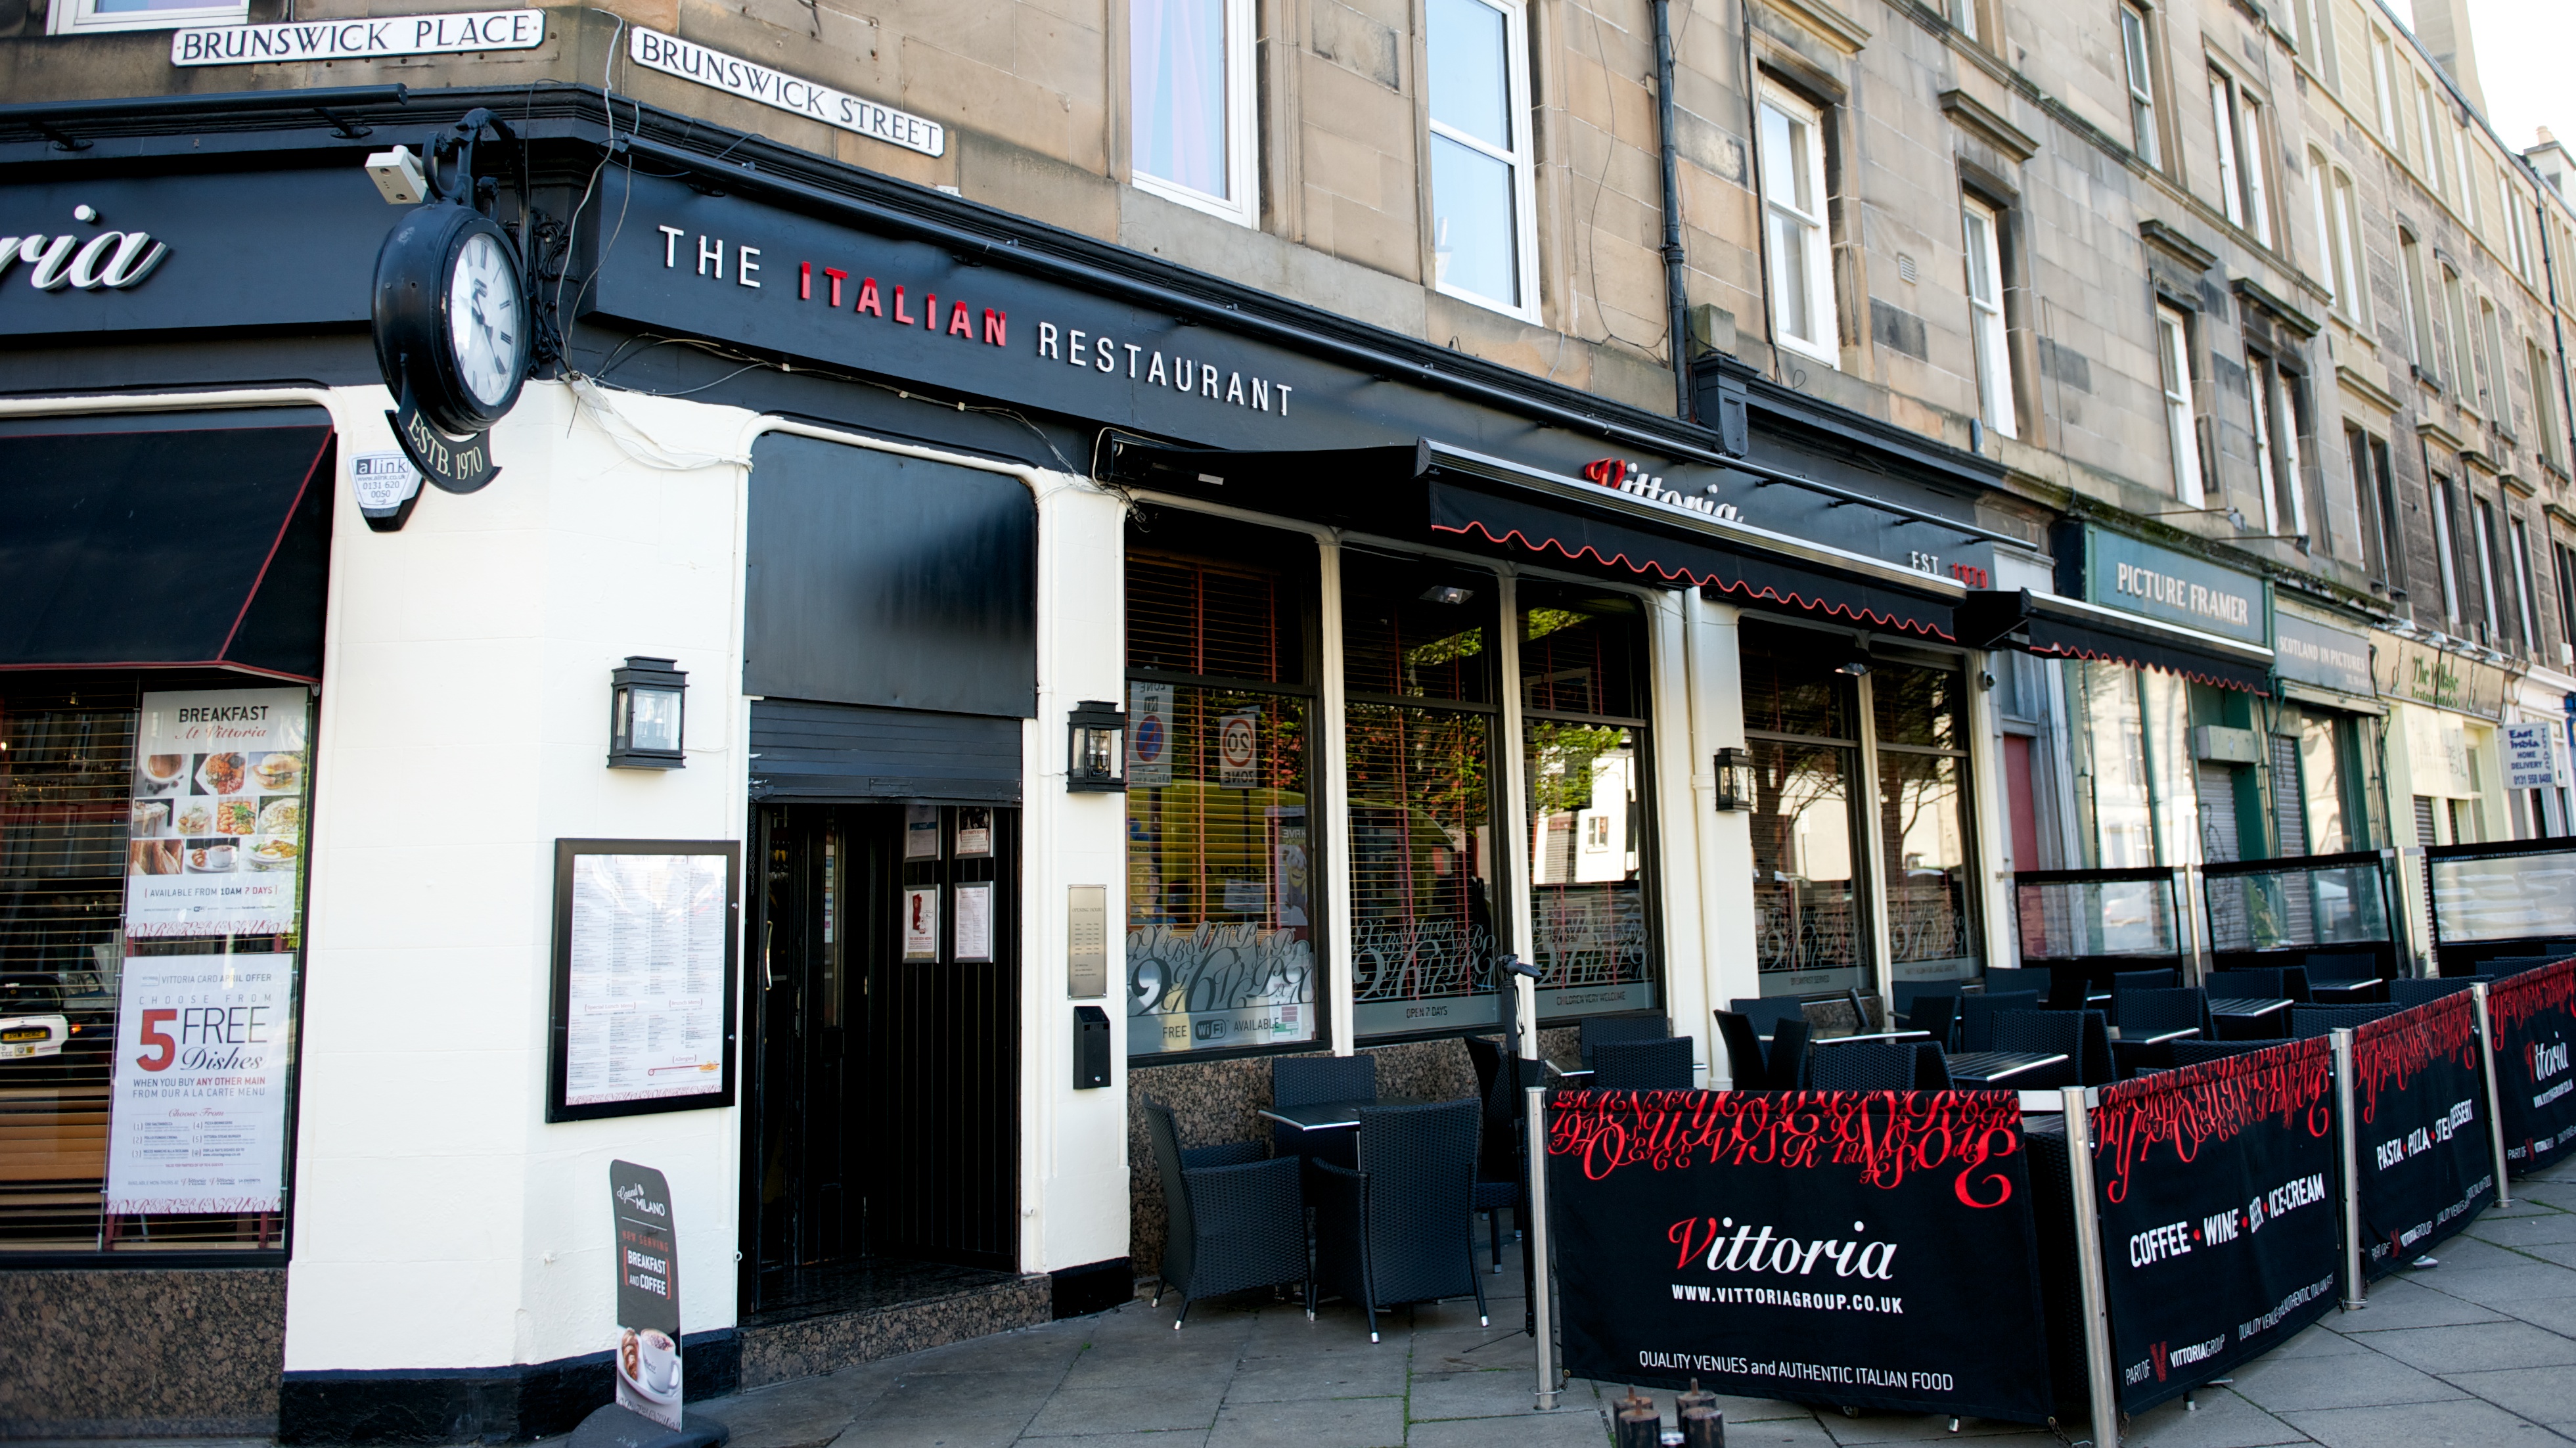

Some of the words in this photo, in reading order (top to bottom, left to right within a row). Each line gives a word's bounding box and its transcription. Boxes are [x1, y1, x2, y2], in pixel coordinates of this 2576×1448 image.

[183, 22, 388, 60] BRUNSWICK
[415, 14, 531, 49] PLACE
[642, 32, 827, 117] BRUNSWICK
[840, 97, 939, 151] STREET
[659, 223, 762, 289] THE
[798, 260, 1008, 348] ITALIAN
[1038, 320, 1293, 418] RESTAURANT
[407, 407, 451, 477] ESTB.
[455, 446, 483, 480] 1970
[357, 459, 408, 475] alink
[371, 489, 391, 498] 0050
[1584, 457, 1745, 523] Vittoria
[1951, 562, 1989, 589] 1970
[2116, 562, 2186, 608] PICTURE
[2189, 583, 2249, 626] FRAMER
[2279, 635, 2318, 663] SCOTLAND
[2320, 646, 2330, 665] IN
[2330, 648, 2366, 673] PICTURES
[2412, 656, 2429, 685] The
[2431, 662, 2459, 693] Vllage
[178, 706, 269, 723] BREAKFAST
[205, 725, 267, 740] Vittoria
[2511, 761, 2543, 771] DELIVERY
[2517, 750, 2537, 759] HOME
[150, 888, 193, 897] AVAILABLE
[194, 887, 217, 897] FROM
[220, 886, 242, 895] 10AM
[244, 886, 250, 894] 7
[252, 885, 273, 894] DAYS
[139, 995, 210, 1005] CHOOSE
[225, 993, 272, 1003] FROM
[1600, 991, 1626, 1003] WELCOME
[1406, 1007, 1424, 1019] OPEN
[1432, 1005, 1448, 1016] DAYS
[135, 1008, 178, 1073] 5
[182, 1006, 271, 1045] FREE
[1162, 1025, 1188, 1039] FREE
[1233, 1017, 1280, 1033] AVAILABLE
[179, 1047, 264, 1071] Dishes
[133, 1078, 158, 1087] WHEN
[160, 1078, 177, 1087] YOU
[178, 1077, 196, 1087] BUY
[196, 1077, 214, 1086] ANY
[214, 1077, 242, 1086] OTHER
[244, 1076, 265, 1085] MAIN
[133, 1089, 158, 1098] FROM
[162, 1089, 181, 1098] OUR
[183, 1088, 190, 1097] A
[192, 1088, 204, 1097] LA
[206, 1087, 235, 1097] CARTE
[238, 1087, 265, 1097] MENU
[168, 1107, 198, 1118] Choose
[199, 1107, 225, 1117] From
[2376, 1137, 2405, 1171] PASTA
[2408, 1126, 2432, 1158] PIZZA
[2435, 1116, 2454, 1144] STEA
[2450, 1098, 2474, 1130] DESSERT
[635, 1197, 666, 1217] MILANO
[2129, 1221, 2192, 1268] COFFEE
[2203, 1208, 2240, 1248] WINE
[2269, 1172, 2326, 1219] ICE-CREAM
[622, 1230, 637, 1242] NOW
[639, 1234, 669, 1253] SERVING
[1667, 1215, 1898, 1282] Vittoria
[627, 1250, 666, 1275] BREAKFAST
[629, 1274, 640, 1286] AND
[640, 1273, 666, 1296] COFFEE
[1671, 1283, 1904, 1315] WWW.VITTORIAGROUP.CO.UK
[2238, 1315, 2262, 1342] QUALITY
[2261, 1307, 2280, 1330] VENUE
[2284, 1286, 2312, 1314] AUTHENTIC
[2310, 1277, 2328, 1300] ITALIAN
[1638, 1350, 1691, 1370] QUALITY
[1692, 1354, 1748, 1374] VENUES
[1750, 1361, 1776, 1377] and
[1778, 1362, 1854, 1384] AUTHENTIC
[1855, 1367, 1907, 1389] ITALIAN
[2125, 1363, 2141, 1387] PART
[2140, 1359, 2151, 1379] OF
